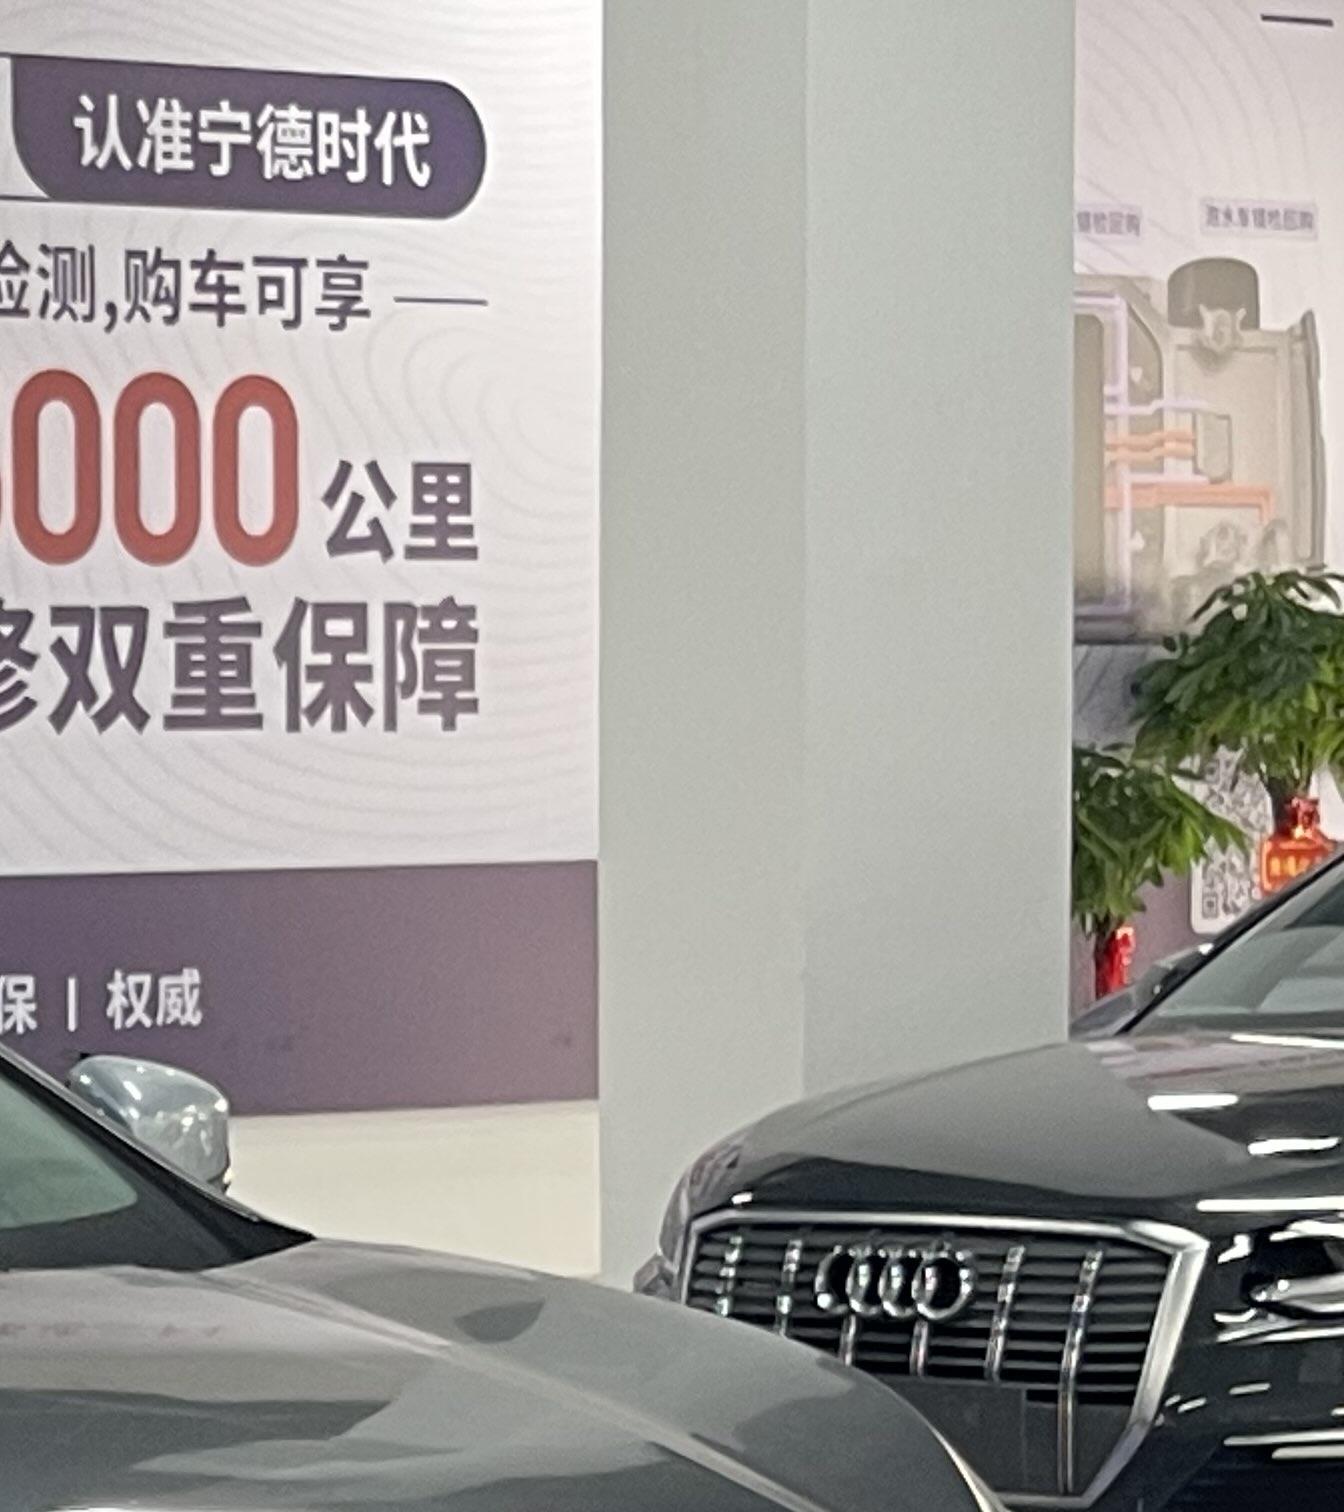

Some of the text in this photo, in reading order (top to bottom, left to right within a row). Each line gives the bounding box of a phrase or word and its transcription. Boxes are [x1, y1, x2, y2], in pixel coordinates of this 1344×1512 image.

[72, 93, 432, 188] 认准宁德时代
[106, 966, 204, 1031] 权威
